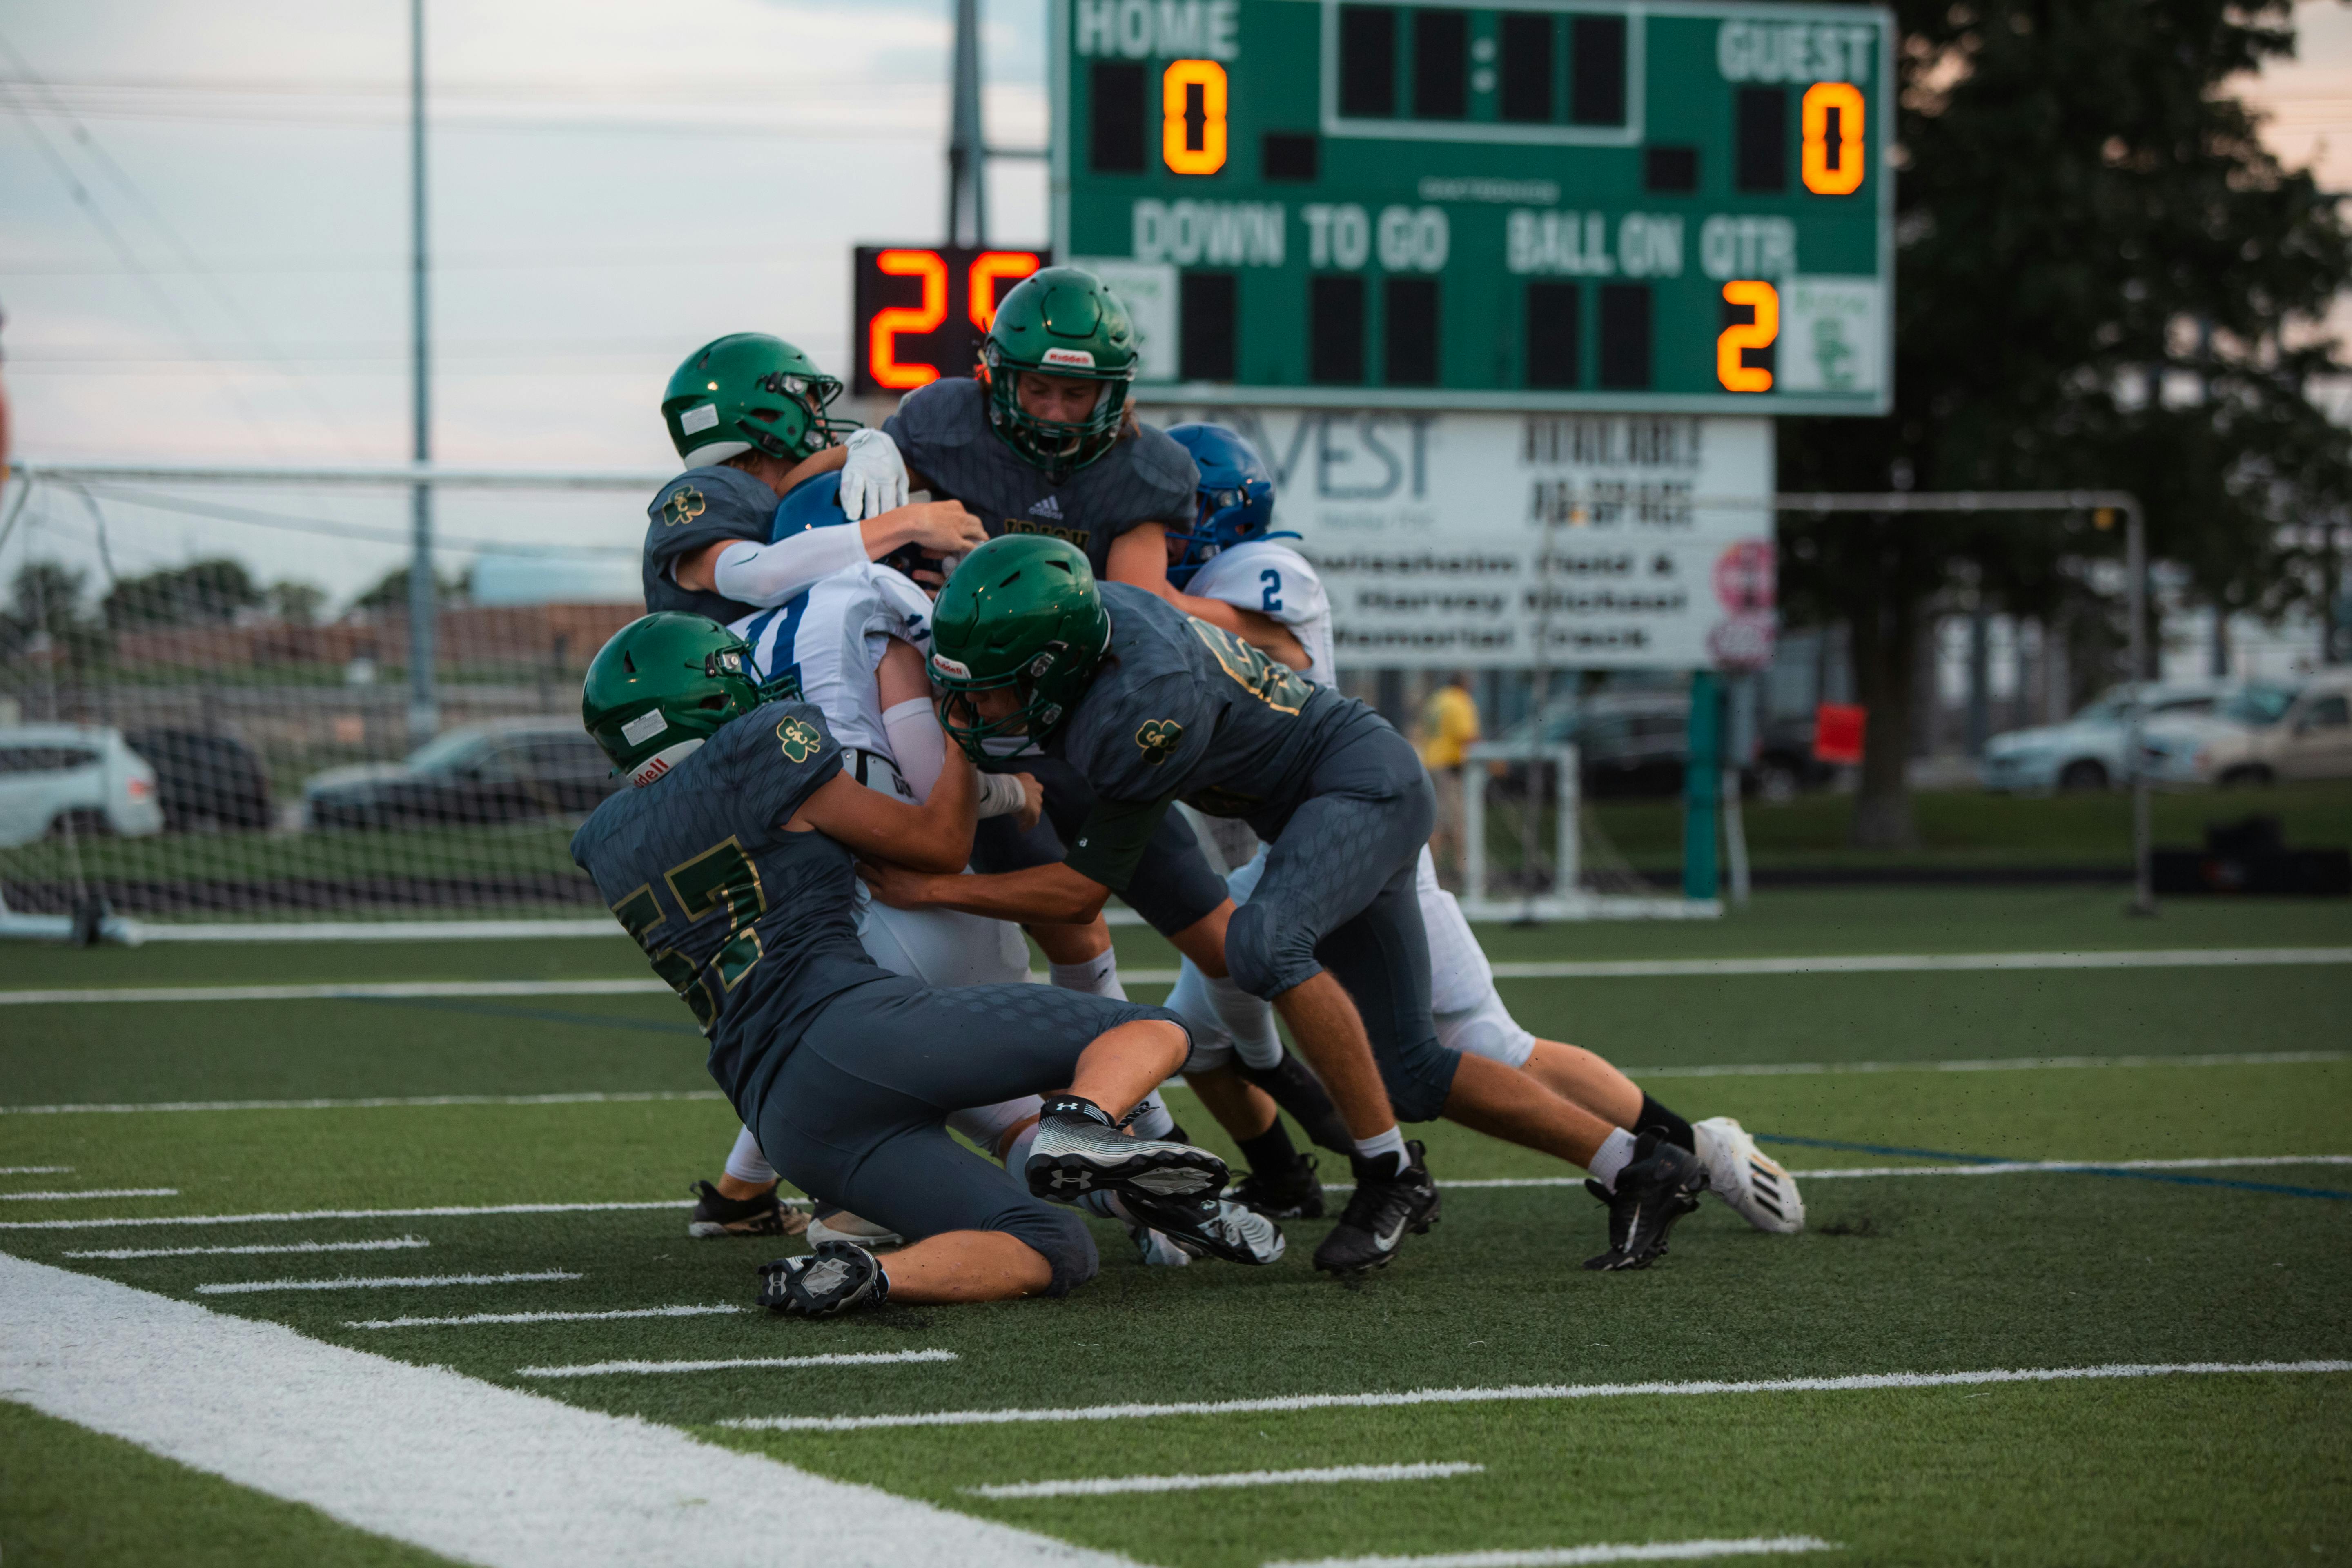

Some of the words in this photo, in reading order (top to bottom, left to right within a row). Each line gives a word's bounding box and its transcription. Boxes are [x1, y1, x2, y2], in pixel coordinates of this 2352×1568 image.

[1076, 0, 1240, 60] HOME
[1718, 21, 1873, 84] GUEST
[1163, 60, 1227, 174] 0
[1802, 82, 1864, 194] 0
[1132, 198, 1286, 268] DOWN
[1302, 203, 1370, 270] TO
[1376, 204, 1450, 273] GO
[1507, 208, 1616, 276] BALL
[1617, 210, 1684, 278] ON
[1699, 213, 1797, 281] QTR
[1717, 281, 1779, 392] 2
[1260, 569, 1282, 611] 2
